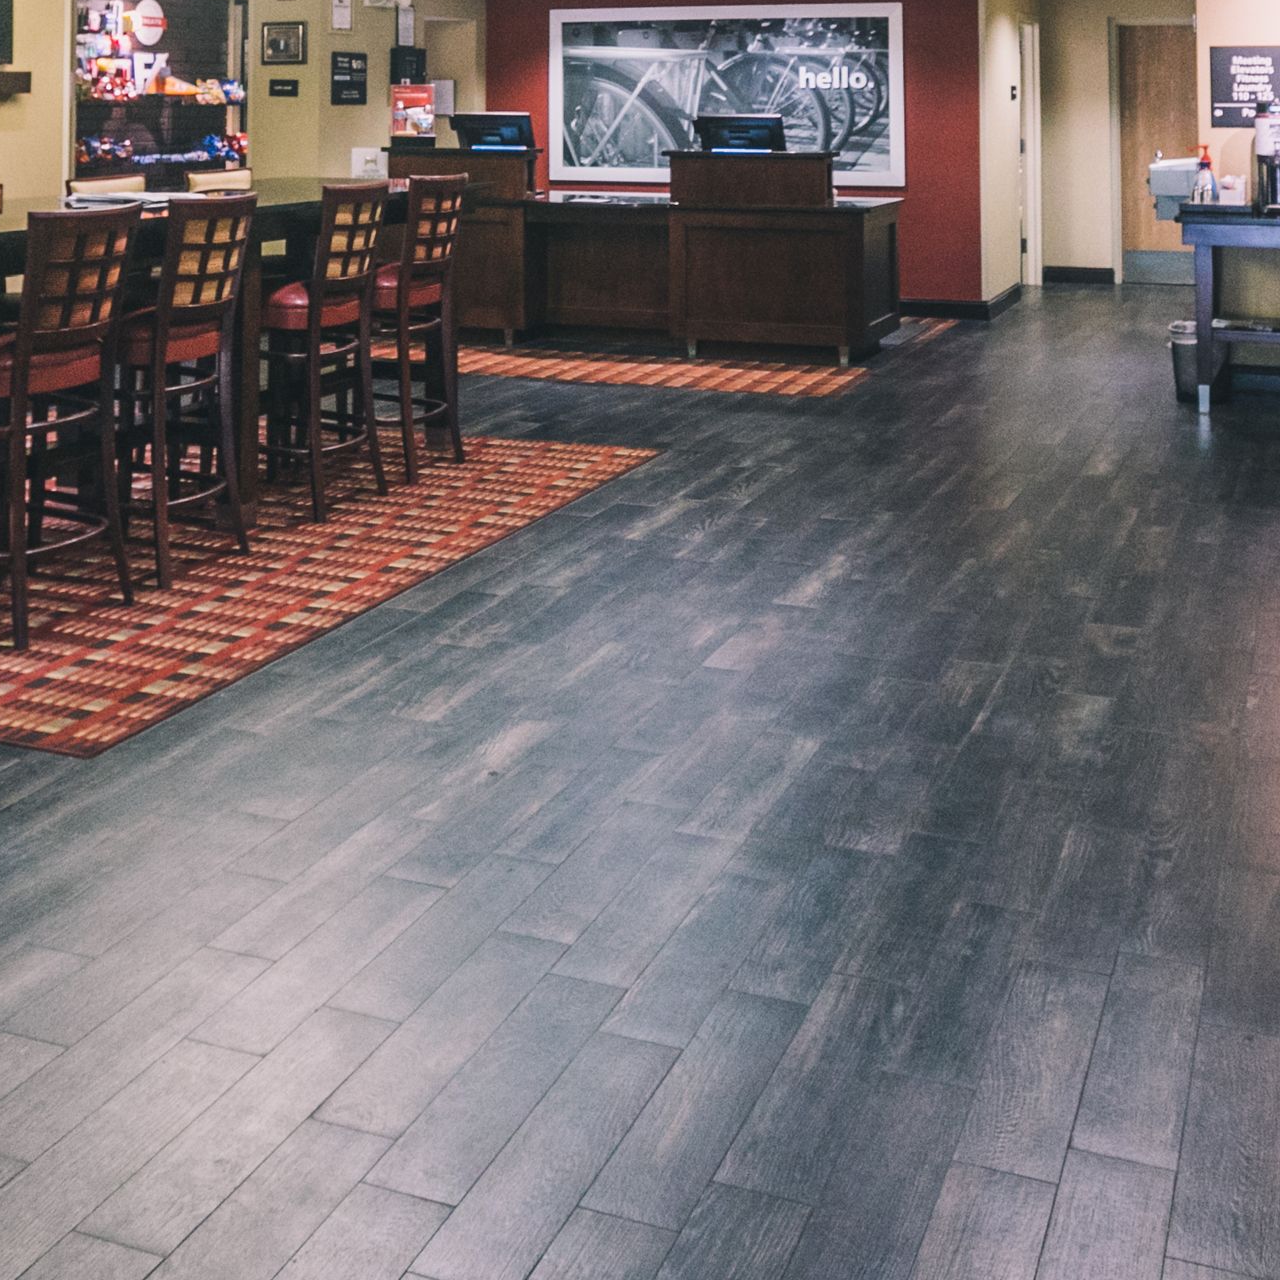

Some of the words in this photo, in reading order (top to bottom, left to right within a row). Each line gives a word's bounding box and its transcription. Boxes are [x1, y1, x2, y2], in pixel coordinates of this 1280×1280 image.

[1232, 55, 1272, 66] Meeting
[1230, 65, 1275, 74] Elevators
[799, 66, 875, 89] hello.
[1235, 74, 1269, 83] Fitness
